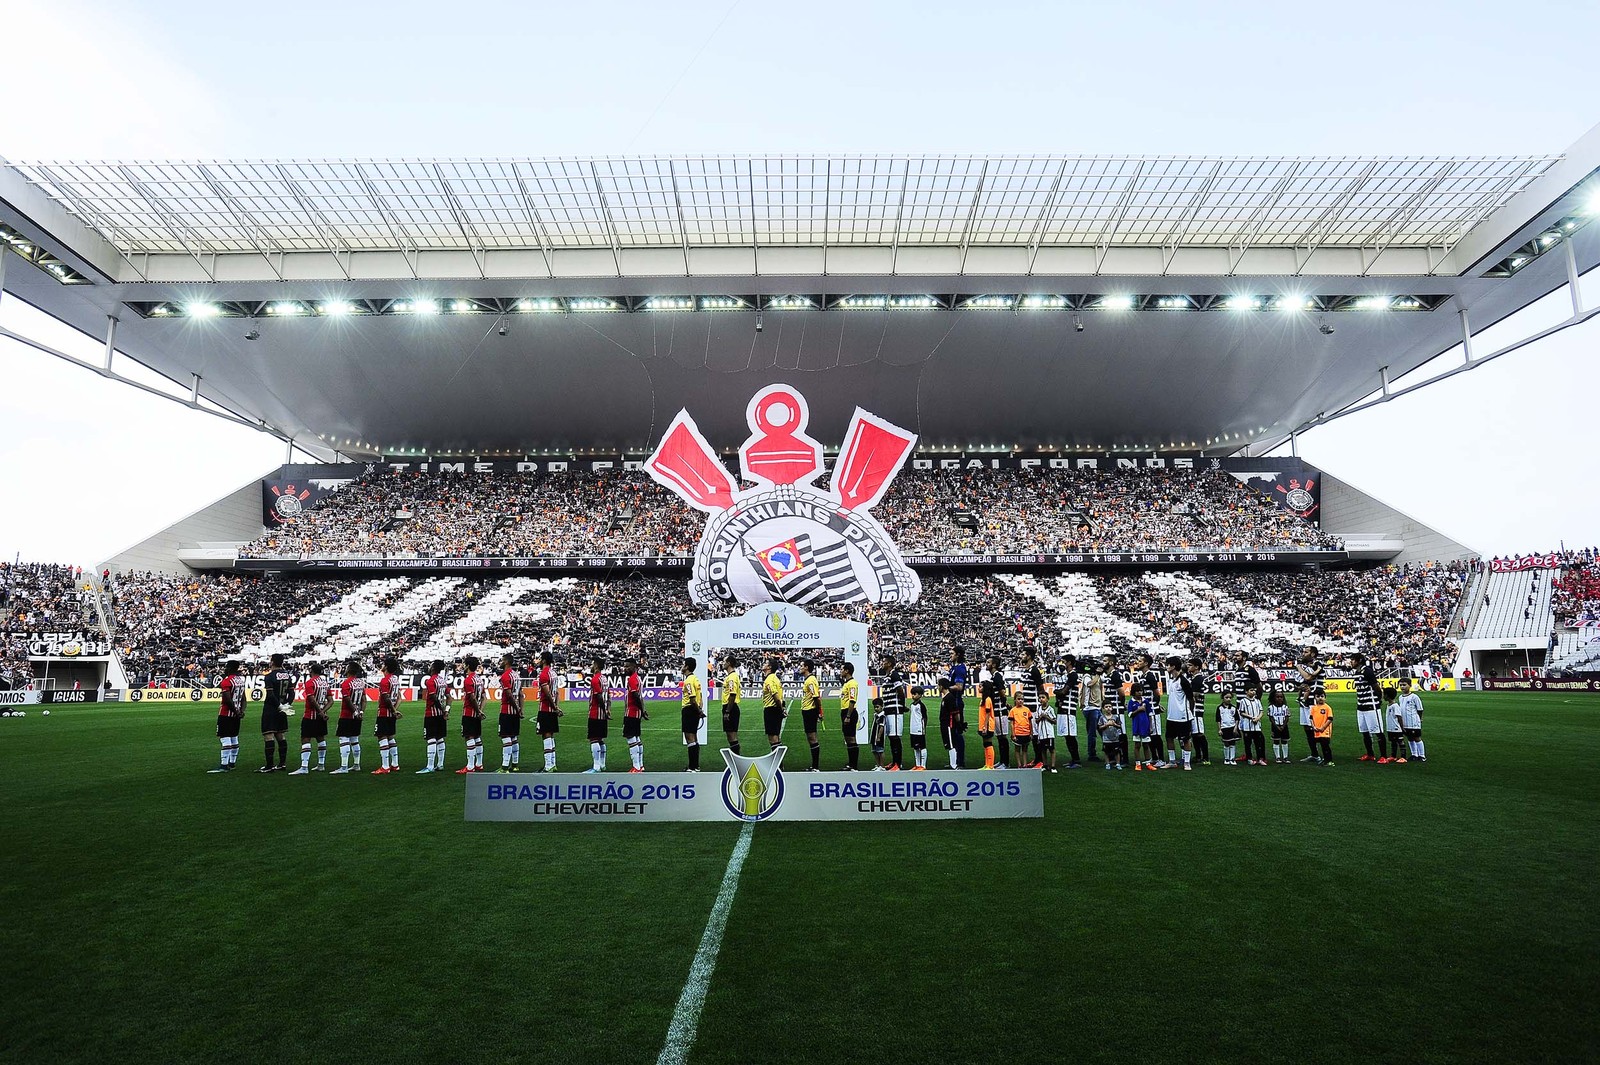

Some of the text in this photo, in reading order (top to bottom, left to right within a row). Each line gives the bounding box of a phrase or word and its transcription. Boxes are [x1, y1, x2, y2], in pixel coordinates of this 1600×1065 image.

[388, 462, 493, 473] TIME
[516, 462, 568, 473] DO
[592, 461, 644, 472] PO
[913, 459, 999, 470] OGAI
[1021, 458, 1098, 470] POR
[709, 502, 898, 602] CORINTHIANS PAULIS
[337, 559, 383, 567] CORINTHIANS
[386, 558, 438, 567] HEXACAMPEÃO
[442, 558, 482, 567] BRASILEIRO
[511, 559, 529, 567] 1990
[550, 559, 568, 567] 1998
[588, 558, 606, 566] 1999
[627, 558, 646, 566] 2005
[667, 558, 686, 566] 2011
[902, 553, 1275, 564] INTHIANS HEXACAMPEÃO BRASILEIRO 1990 1998 1999 2005 2011 2015
[732, 632, 794, 640] BRASILEIRÃO
[924, 686, 940, 697] aú
[1274, 681, 1295, 692] elo
[0, 692, 25, 703] MOS
[52, 692, 85, 702] IGUAIS
[132, 691, 141, 700] 51
[192, 691, 201, 699] 51
[252, 690, 262, 699] 51
[740, 689, 824, 699] SILEIR HEVRT
[487, 781, 696, 800] BRASILEIRÃO 2015
[808, 778, 1021, 798] BRASILEIRÃO 2015
[533, 802, 648, 815] CHEVROLET
[857, 798, 973, 812] CHEVROLET
